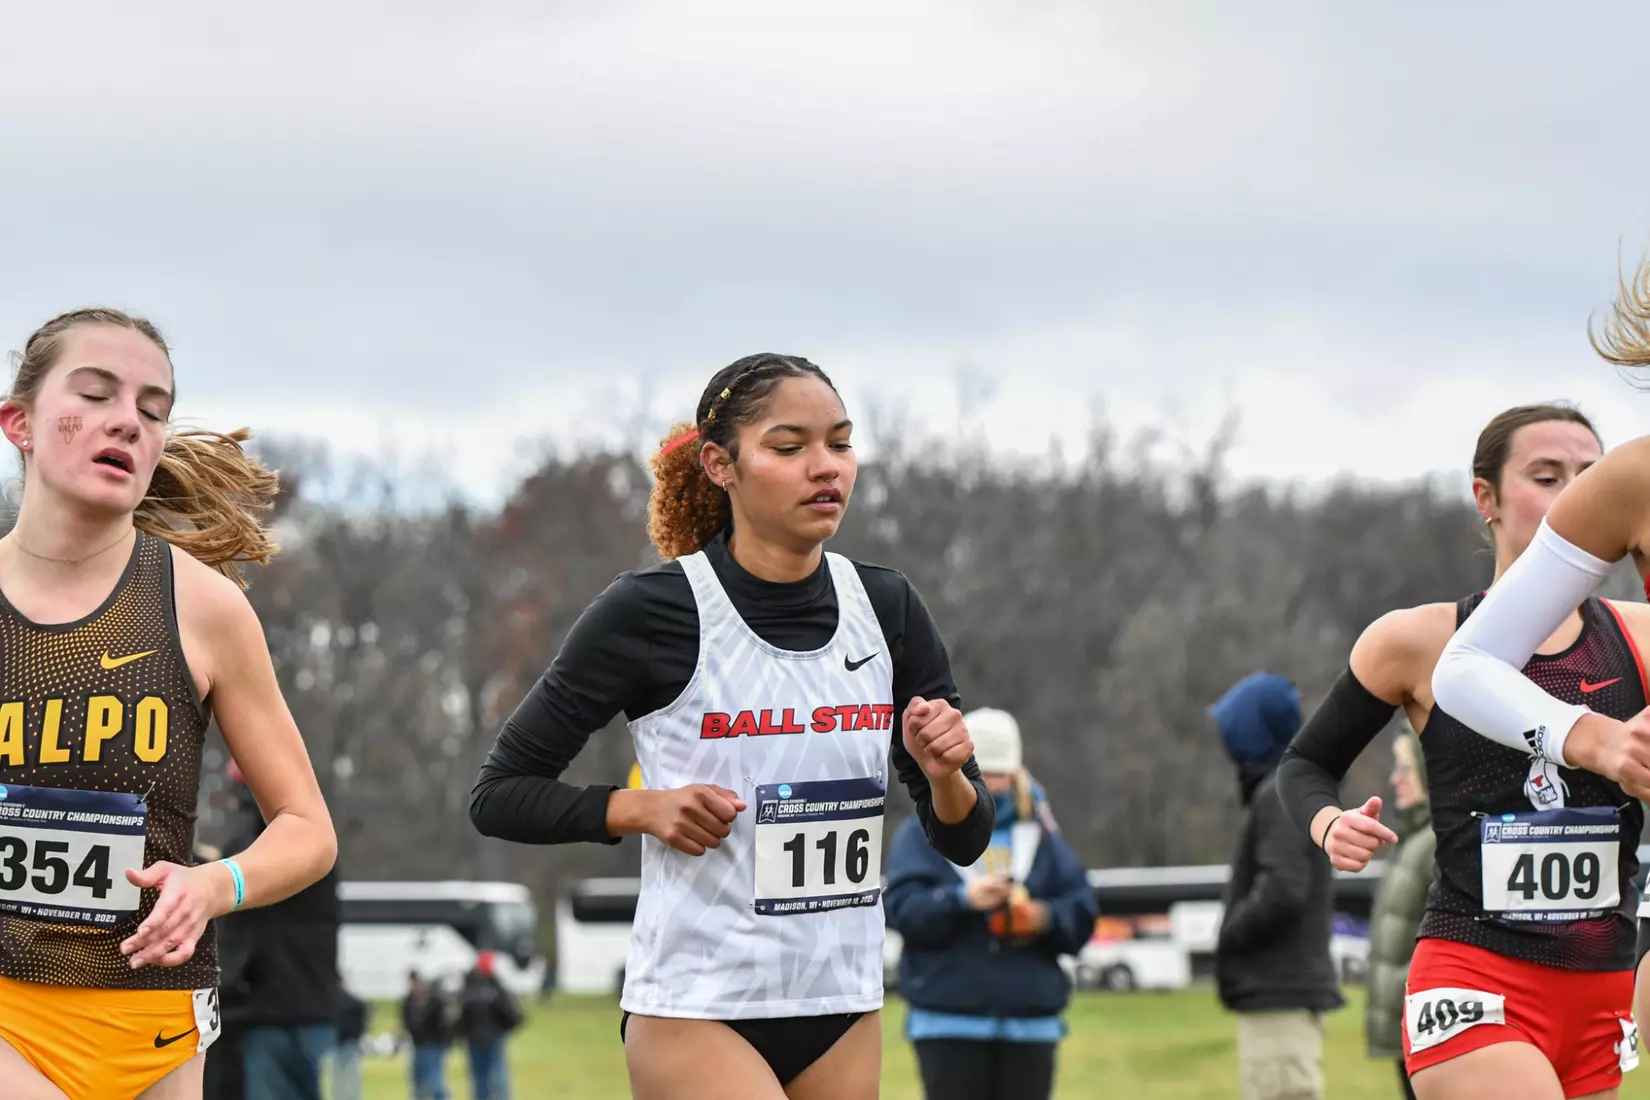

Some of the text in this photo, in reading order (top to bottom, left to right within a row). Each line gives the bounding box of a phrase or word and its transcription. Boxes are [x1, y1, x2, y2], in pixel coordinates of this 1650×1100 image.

[699, 703, 895, 740] BALL STATE
[22, 808, 66, 821] COUNTRY
[67, 811, 145, 827] CHAMPIONSHIPS
[778, 803, 804, 814] CROSS
[804, 801, 839, 812] COUNTRY
[839, 796, 885, 811] CHAMPIONSHIPS
[1501, 824, 1620, 836] CROSS COUNTRY CHAMPIONSHIPS
[0, 836, 113, 899] 354
[783, 828, 870, 887] 116
[1507, 852, 1600, 900] 409
[21, 906, 31, 914] WI
[37, 908, 81, 920] NOVEMBER
[82, 912, 93, 921] 10,
[94, 913, 117, 923] 2023
[774, 903, 808, 911] MADISON,
[821, 898, 852, 908] NOVEMBER
[1416, 998, 1484, 1036] 409
